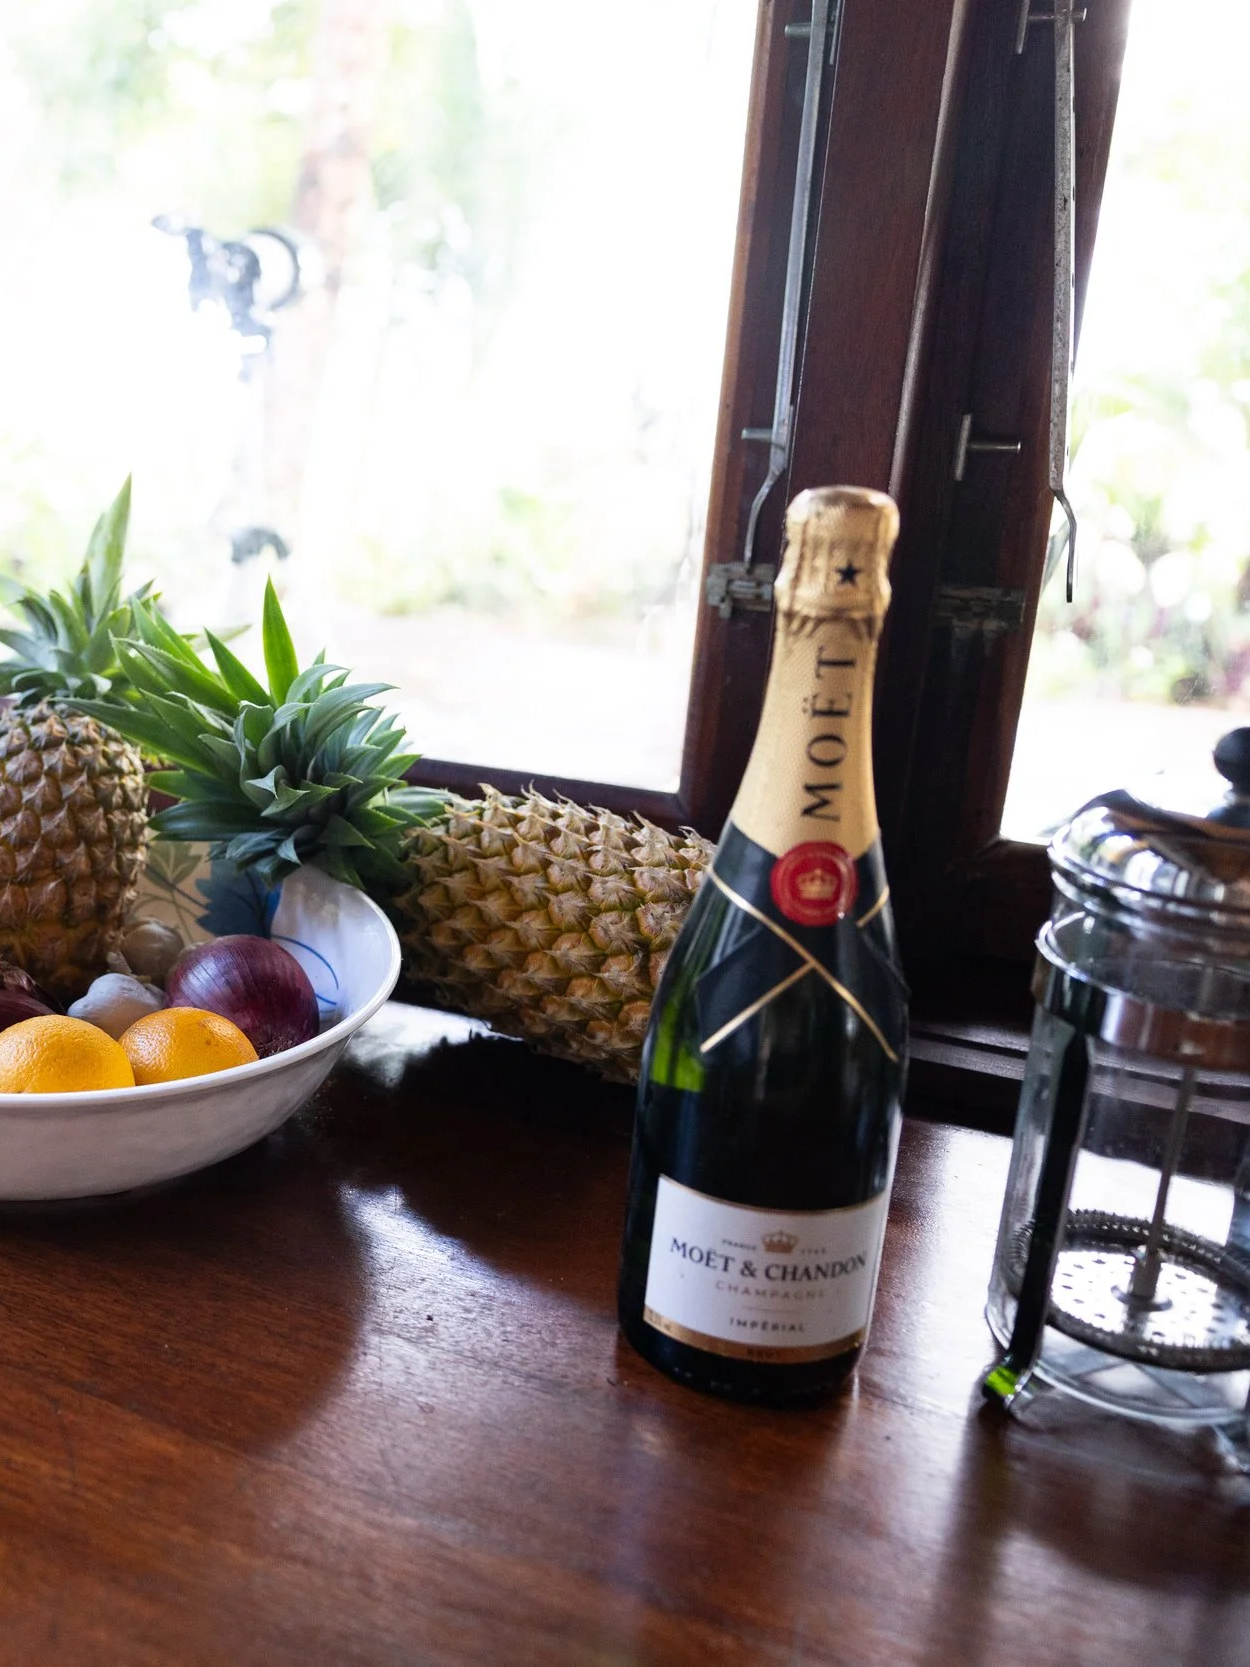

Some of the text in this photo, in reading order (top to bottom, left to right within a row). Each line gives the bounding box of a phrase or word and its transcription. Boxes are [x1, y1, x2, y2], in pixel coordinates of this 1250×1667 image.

[800, 645, 857, 822] MOËT
[670, 1237, 868, 1282] MOËT & CHANDON
[715, 1280, 827, 1300] CHAMPAGNE
